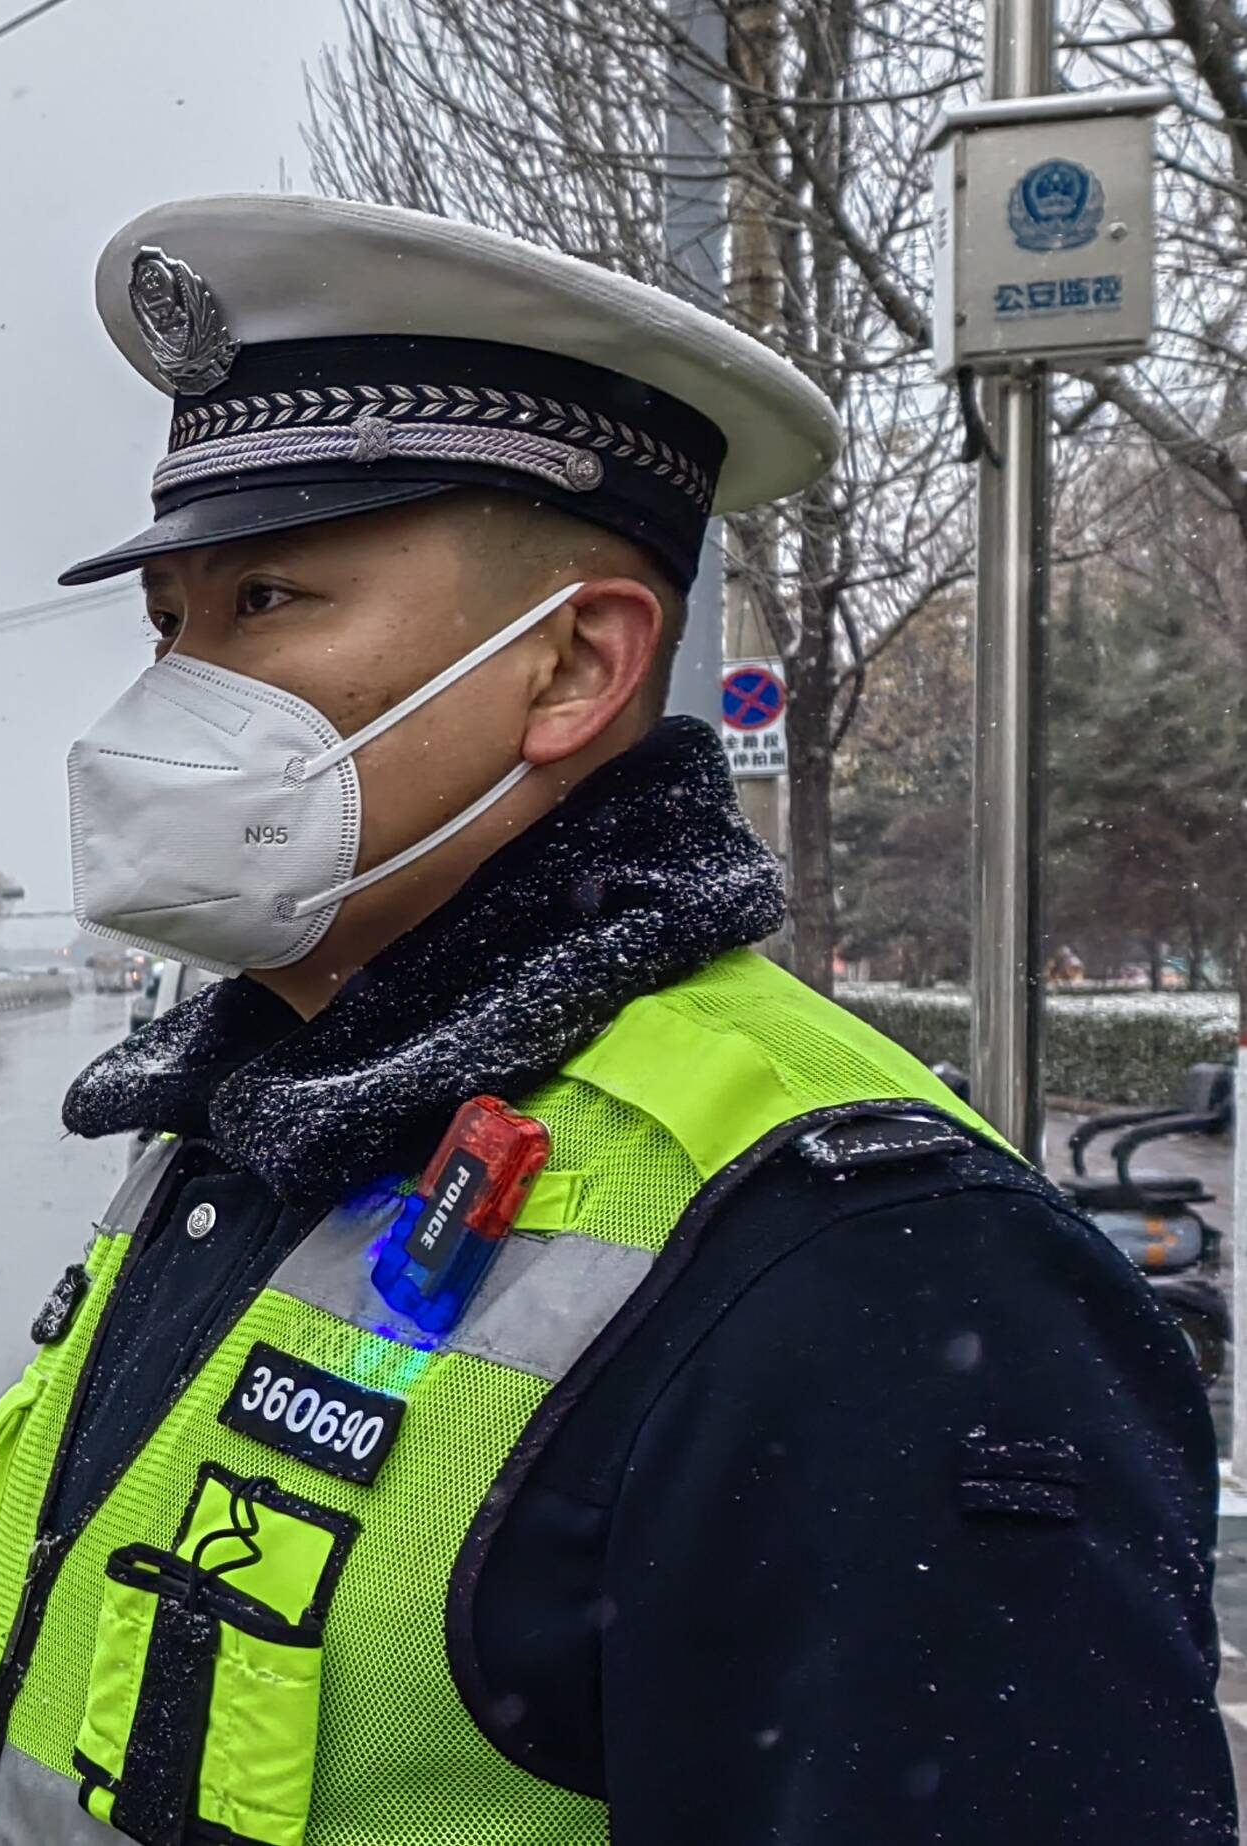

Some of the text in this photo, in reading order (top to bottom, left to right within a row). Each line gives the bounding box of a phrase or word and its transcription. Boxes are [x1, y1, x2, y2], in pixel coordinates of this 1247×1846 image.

[244, 826, 289, 845] N95
[420, 1165, 471, 1251] POLICE
[242, 1366, 384, 1461] 360690
